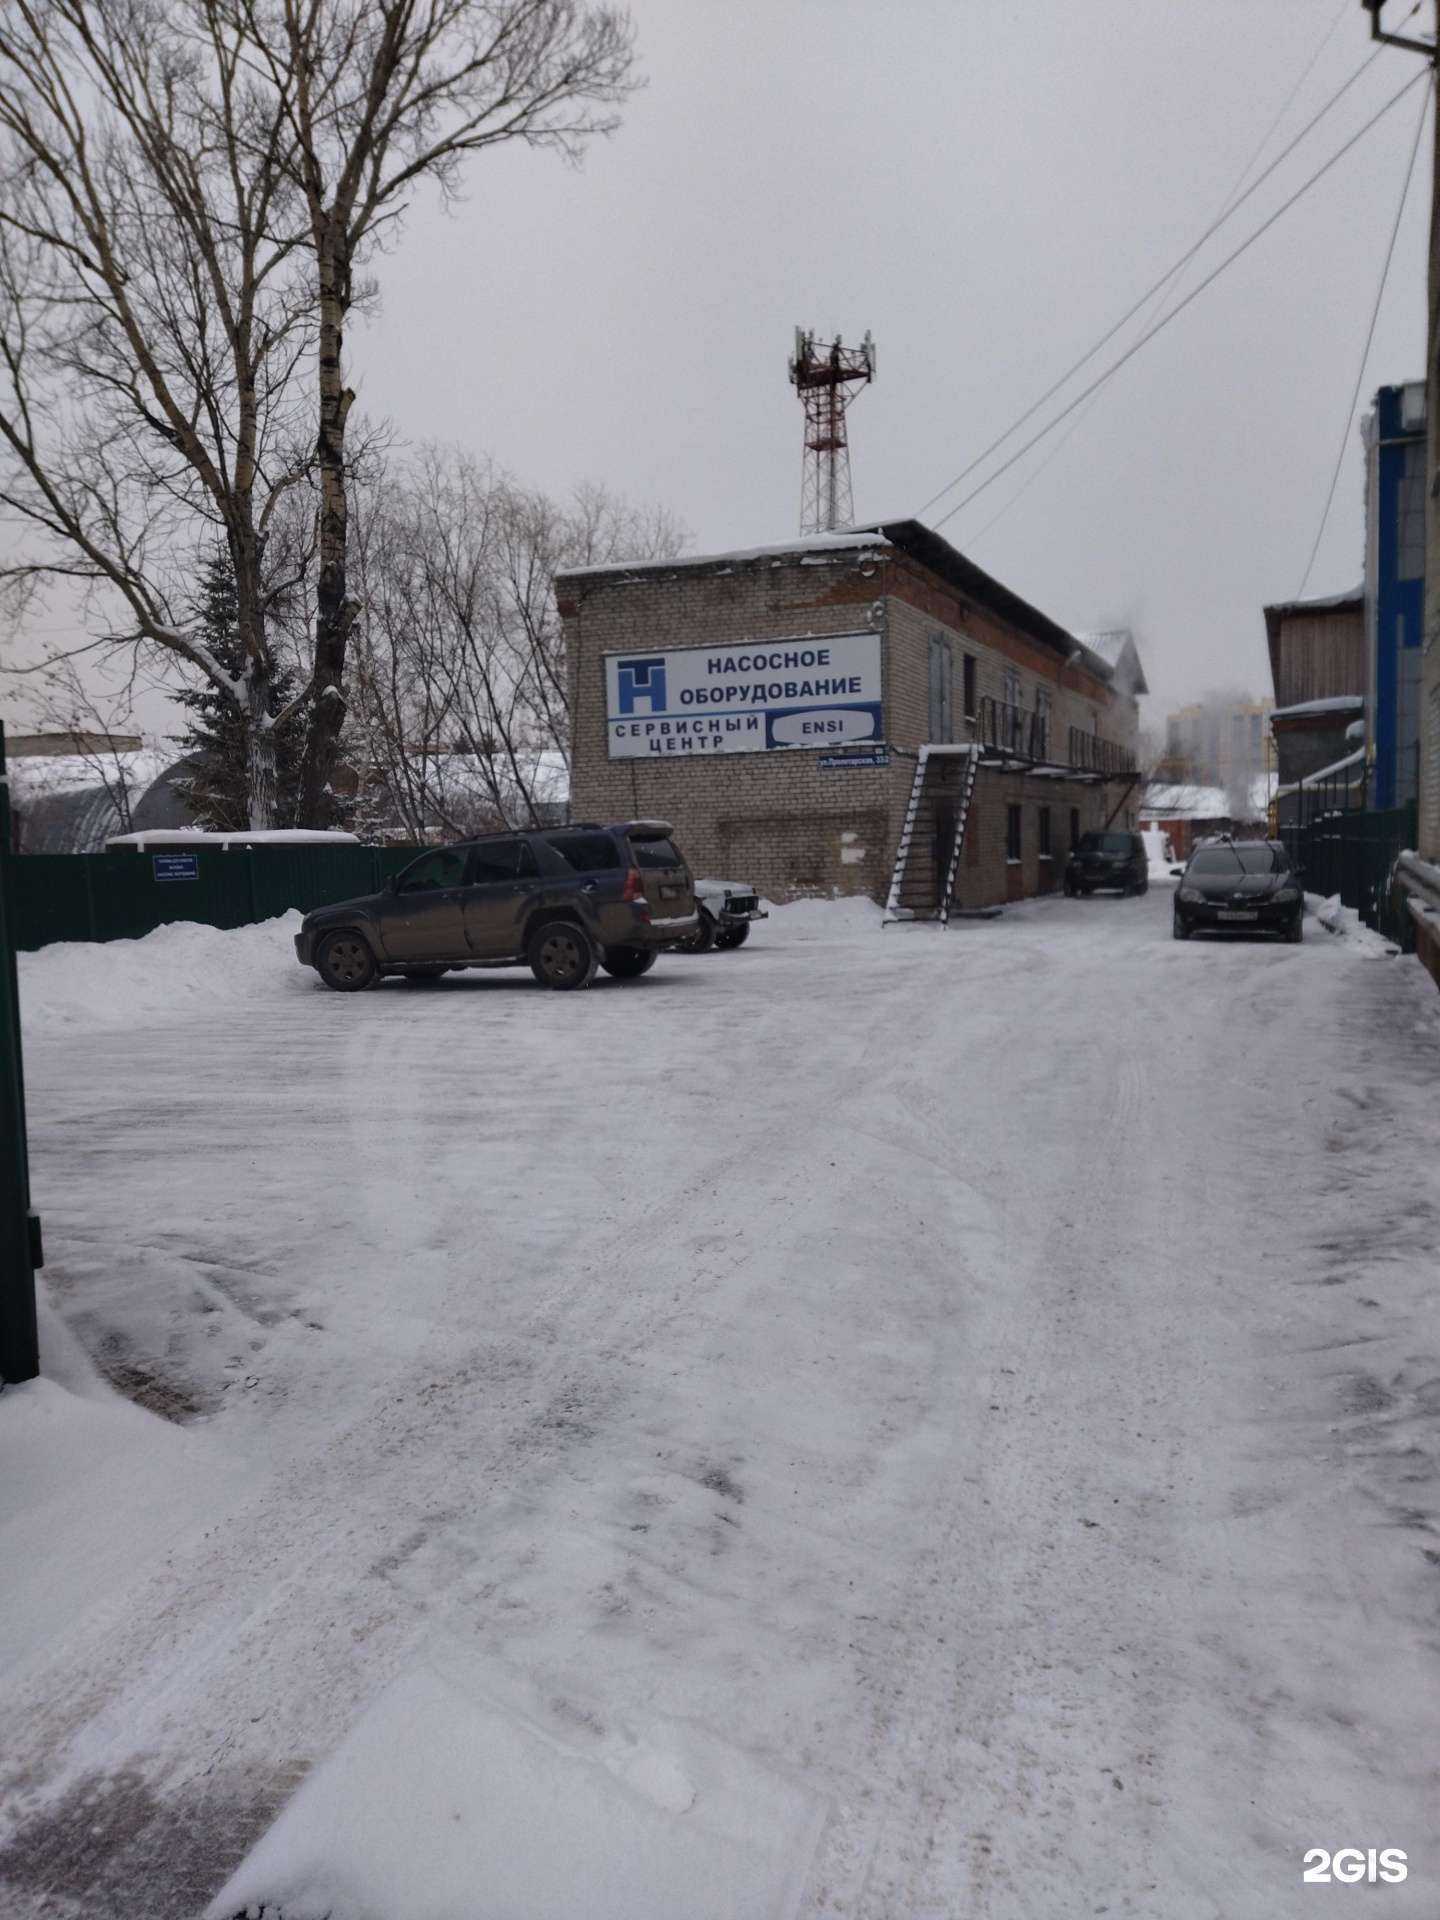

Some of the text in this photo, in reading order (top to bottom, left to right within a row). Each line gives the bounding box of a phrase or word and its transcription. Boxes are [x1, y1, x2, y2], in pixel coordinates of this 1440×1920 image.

[708, 649, 831, 674] НАСОСНОЕ
[680, 677, 863, 705] ОБОРУДОВАНИЕ
[615, 714, 759, 738] СЕРВИСНЫЙ
[802, 719, 844, 734] ENSI
[649, 735, 724, 752] ЦЕНТР
